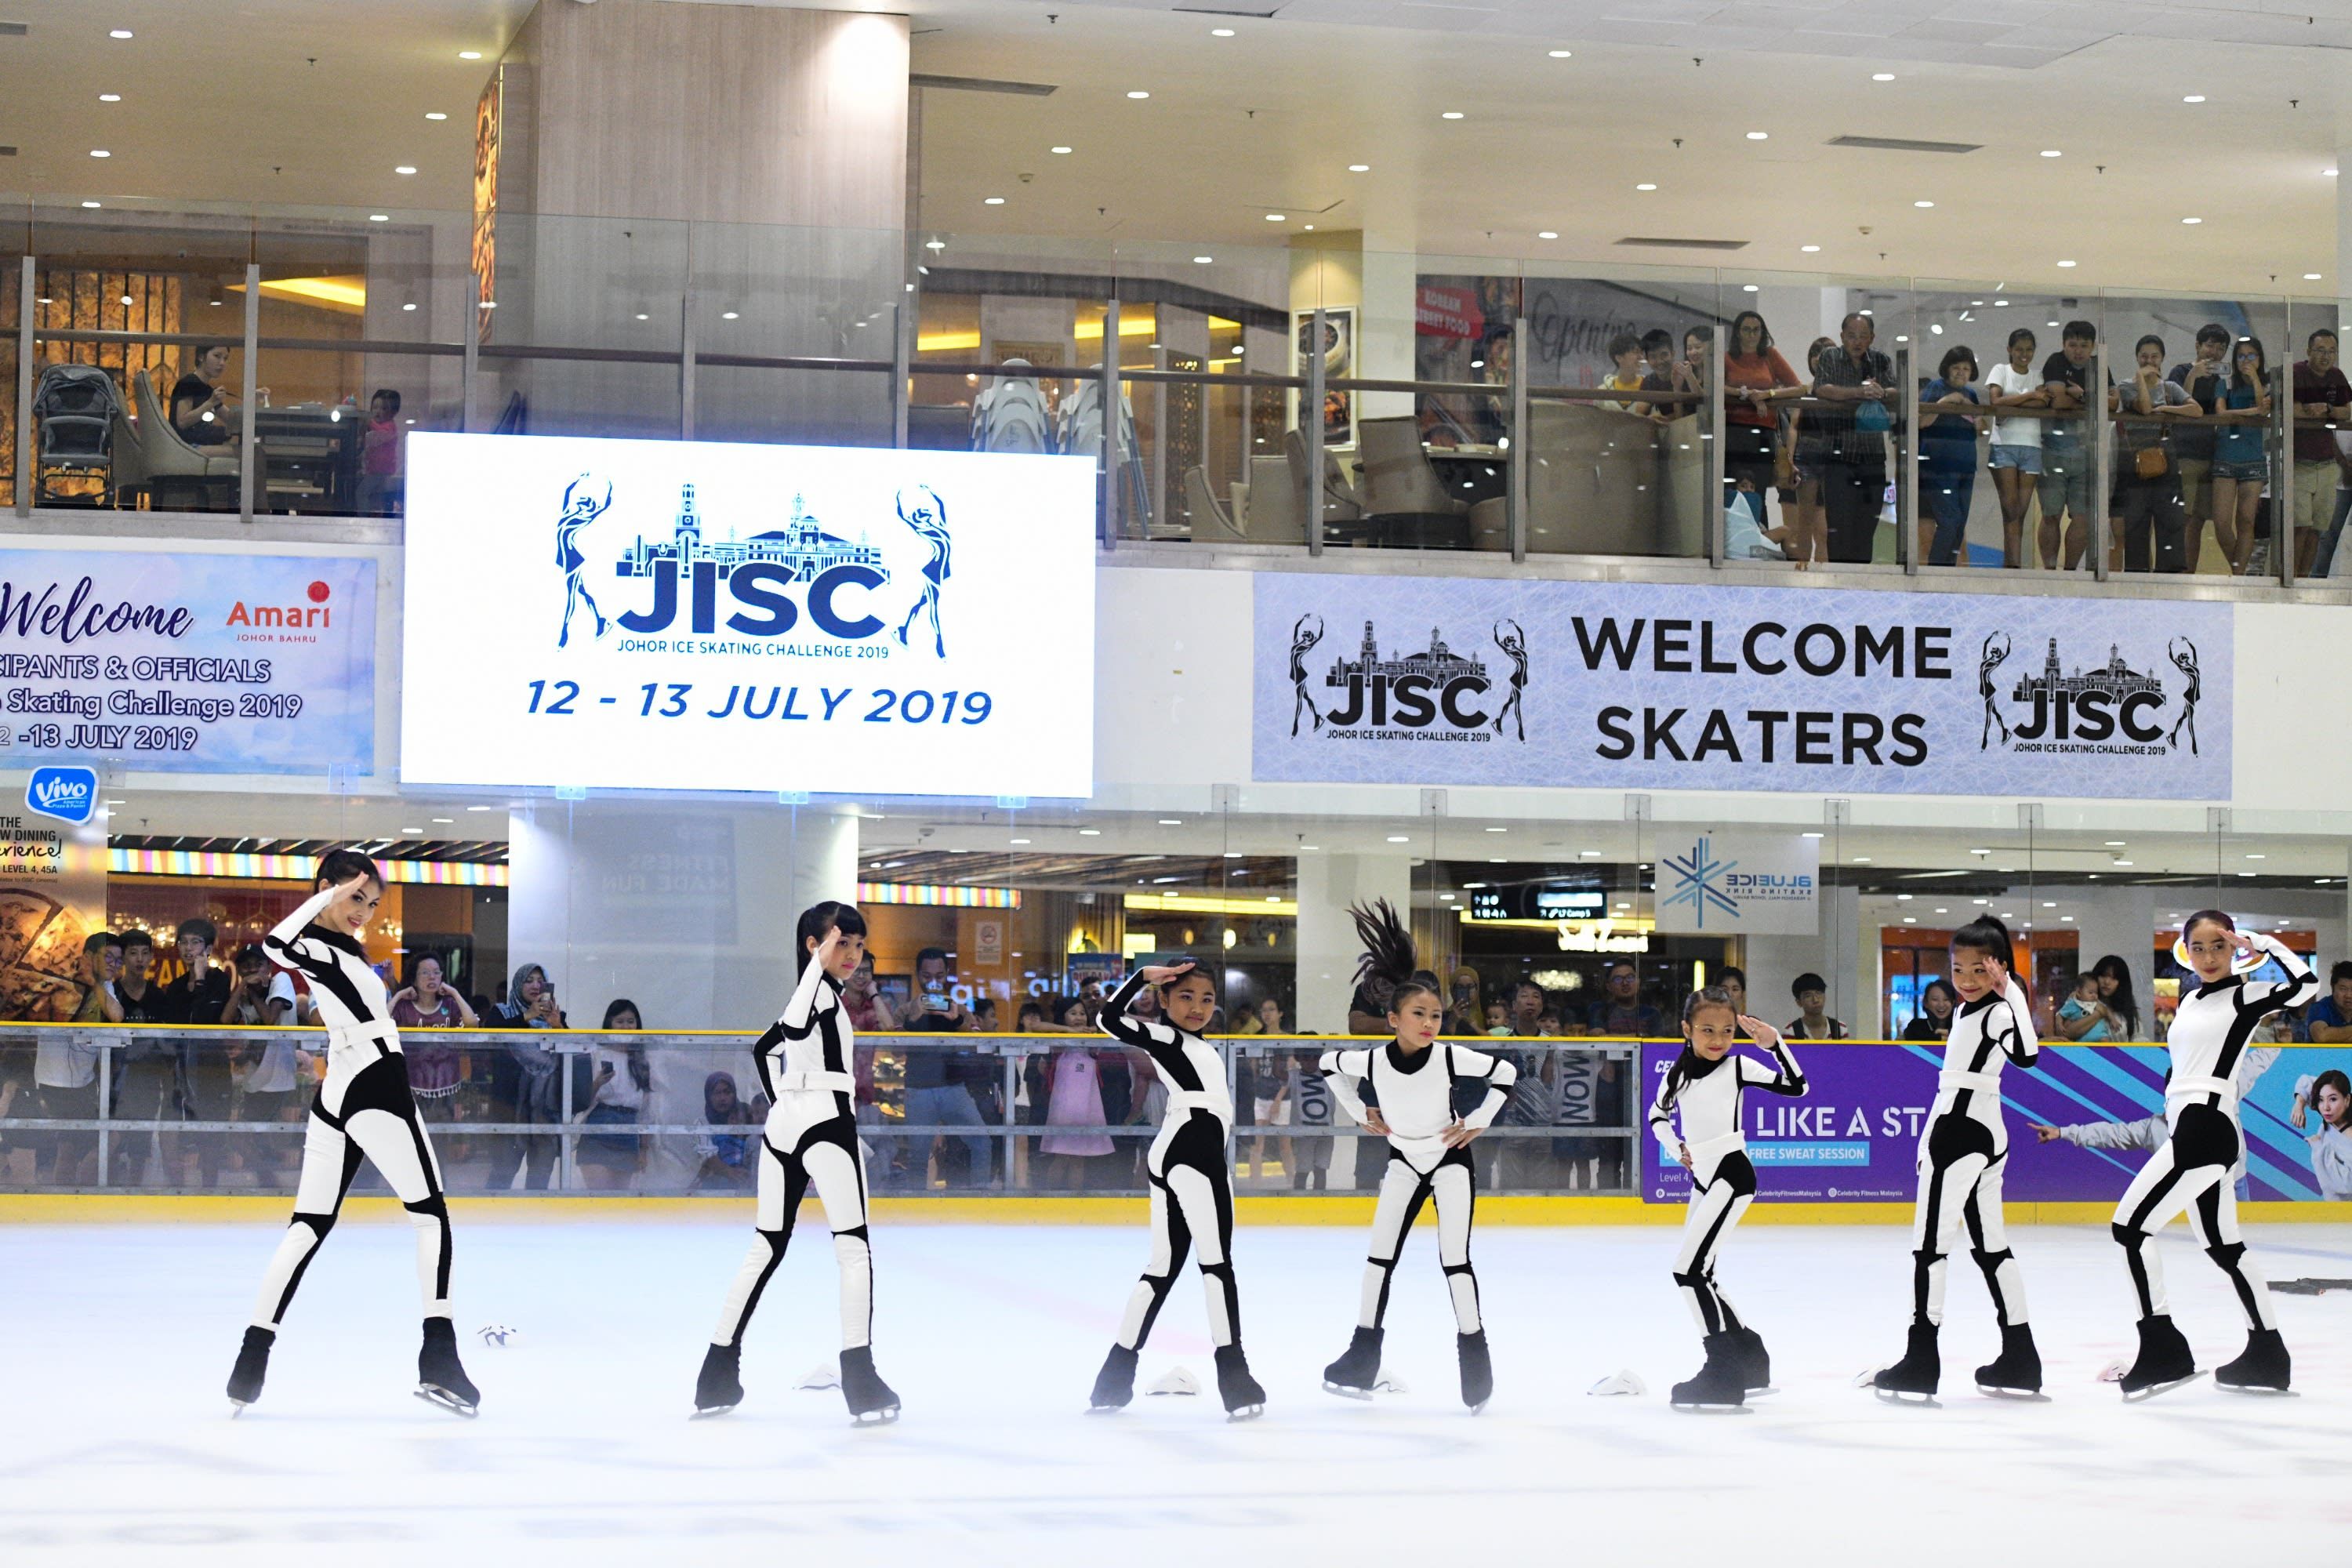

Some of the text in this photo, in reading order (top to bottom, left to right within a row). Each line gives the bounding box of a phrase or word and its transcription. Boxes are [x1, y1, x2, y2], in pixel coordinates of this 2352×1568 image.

[0, 575, 194, 644] Welcome
[226, 580, 330, 628] Amari
[617, 558, 887, 640] JISC
[237, 633, 316, 643] JOHOR BAHRU
[618, 639, 889, 659] JOHOR ICE SKATING CHALLENGE 2019
[1570, 616, 1952, 679] WELCOME
[0, 654, 271, 684] IPANTS & OFFICIALS
[6, 687, 303, 722] Skating Challenge 2019
[526, 679, 580, 715] 12
[640, 683, 693, 717] 13
[706, 685, 853, 722] JULY
[863, 689, 993, 725] 2019
[1326, 673, 1490, 729] JISC
[2013, 689, 2165, 743] JISC
[65, 724, 132, 749] JULY
[134, 725, 198, 750] 2019
[1327, 730, 1491, 742] JOHOR ICE SKATING CHALLENGE 2019
[1595, 705, 1928, 767] SKATERS
[2013, 742, 2166, 755] JOHOR ICE SKATING CHALLENGE 2019
[0, 816, 21, 828] THE
[16, 830, 56, 841] DINING
[3, 865, 57, 874] LEVEL 4, 45A
[1757, 1106, 1835, 1137] LIKE
[1846, 1106, 1871, 1137] A
[1749, 1147, 1865, 1160] FREE SWEAT SESSION
[1660, 1173, 1682, 1182] Level
